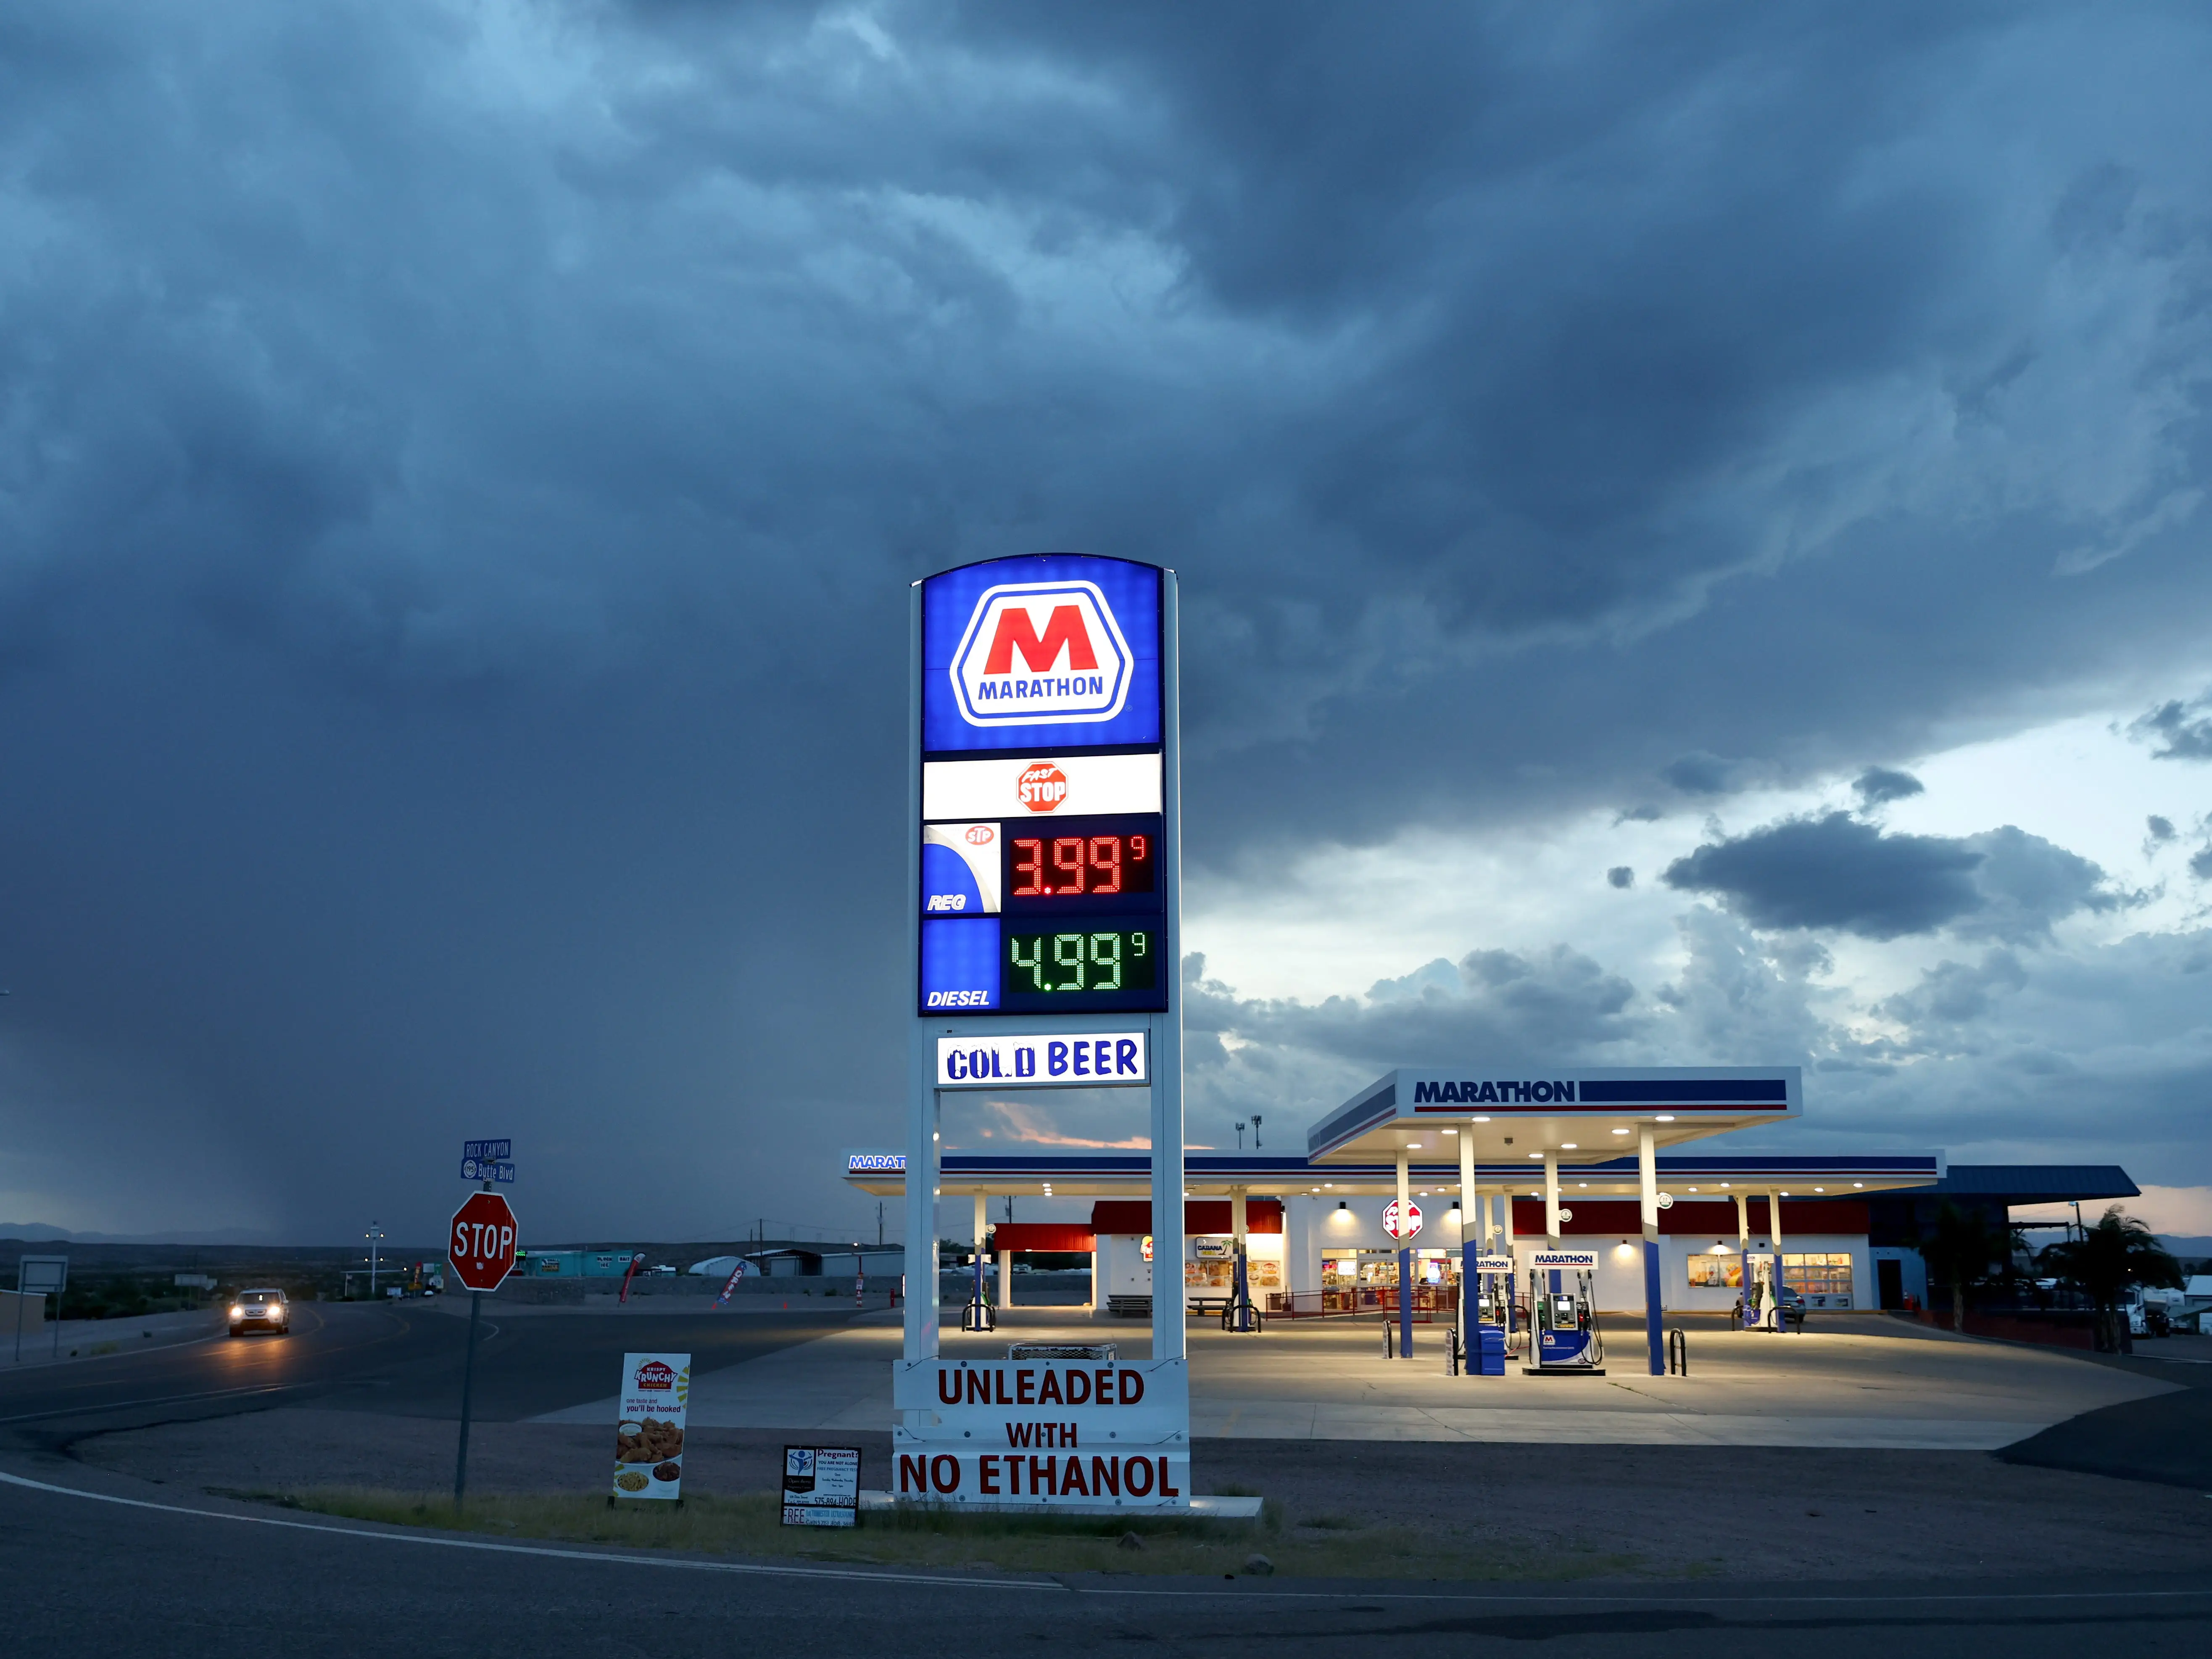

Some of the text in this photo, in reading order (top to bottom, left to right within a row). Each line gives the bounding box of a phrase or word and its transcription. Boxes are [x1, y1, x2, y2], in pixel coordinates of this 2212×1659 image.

[984, 605, 1099, 675] M
[978, 676, 1103, 700] MARATHON
[1021, 767, 1057, 782] FAST
[1020, 781, 1066, 803] STOP
[968, 827, 991, 843] STP
[1014, 836, 1145, 895] 3.99 9
[927, 894, 966, 911] REG
[1011, 932, 1146, 991] 4.99 9
[927, 990, 990, 1007] DIESEL
[947, 1039, 1138, 1079] COLD BEER
[1414, 1081, 1575, 1102] MARATHON
[466, 1141, 509, 1158] ROCK CANYON
[477, 1163, 496, 1179] Butte
[499, 1166, 513, 1181] Blvd
[849, 1155, 906, 1169] MARAT
[454, 1221, 513, 1260] STOP
[635, 1370, 678, 1383] KRUNCHY
[938, 1369, 1144, 1405] UNLEADED
[1005, 1422, 1077, 1448] WITH
[899, 1454, 1179, 1497] NO ETHANOL
